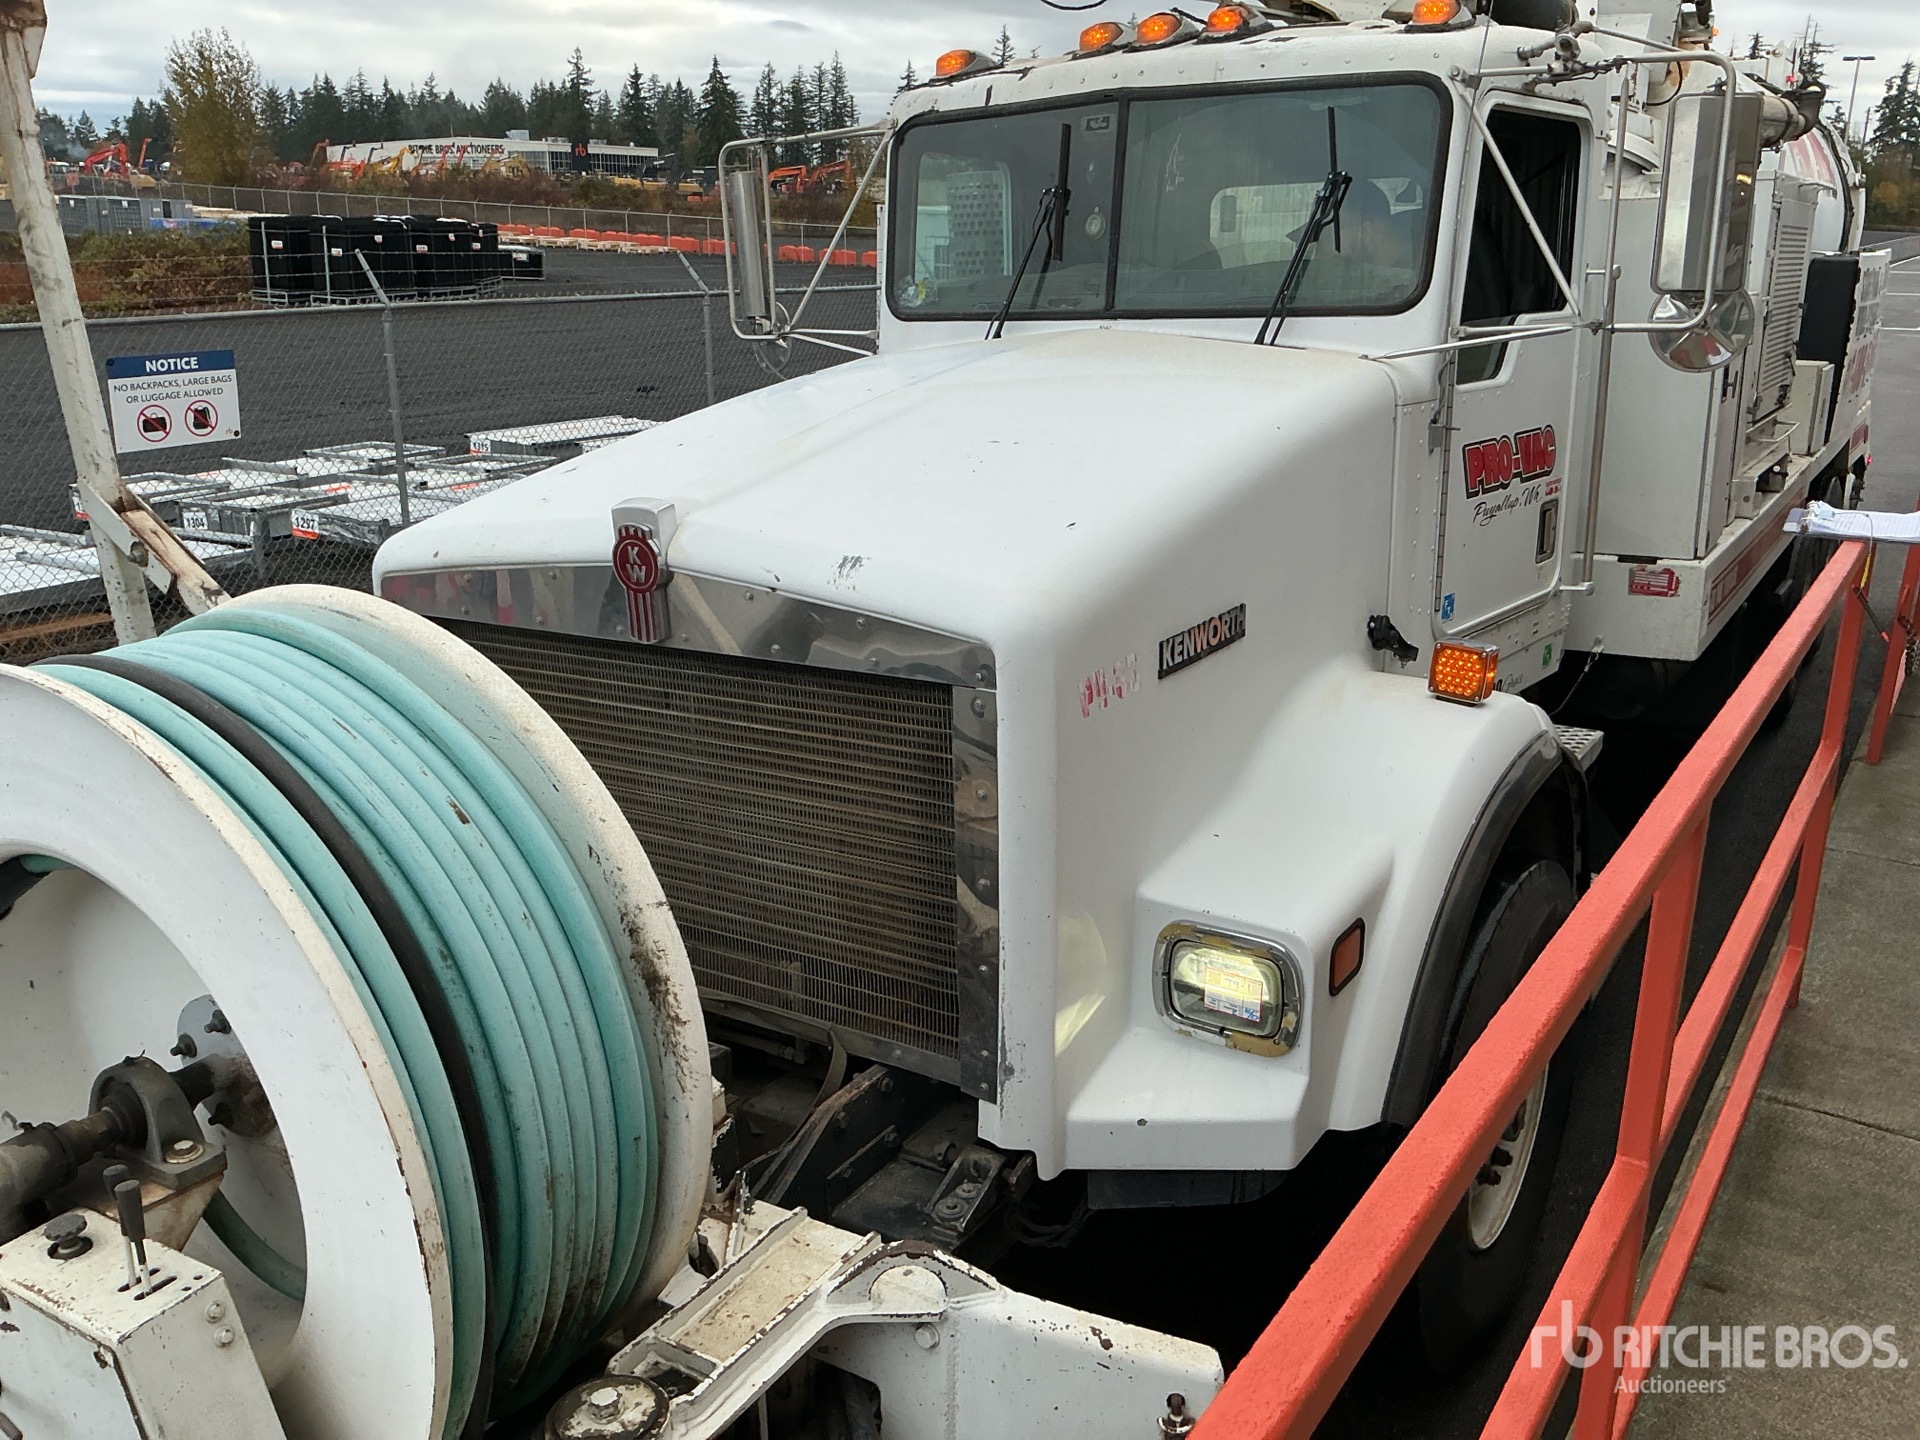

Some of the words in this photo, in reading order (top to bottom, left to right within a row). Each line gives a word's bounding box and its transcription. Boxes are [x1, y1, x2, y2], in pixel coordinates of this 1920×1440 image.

[145, 357, 199, 372] NOTICE
[113, 384, 129, 392] NO
[130, 379, 181, 391] BACKPACKS,
[182, 377, 209, 387] LARGE
[210, 375, 232, 383] BAGS
[126, 395, 139, 404] OR
[141, 391, 181, 403] LUGGAGE
[183, 387, 224, 398] ALLOWED
[1463, 425, 1556, 498] PRO-VAC
[1161, 604, 1246, 669] KENWORTH
